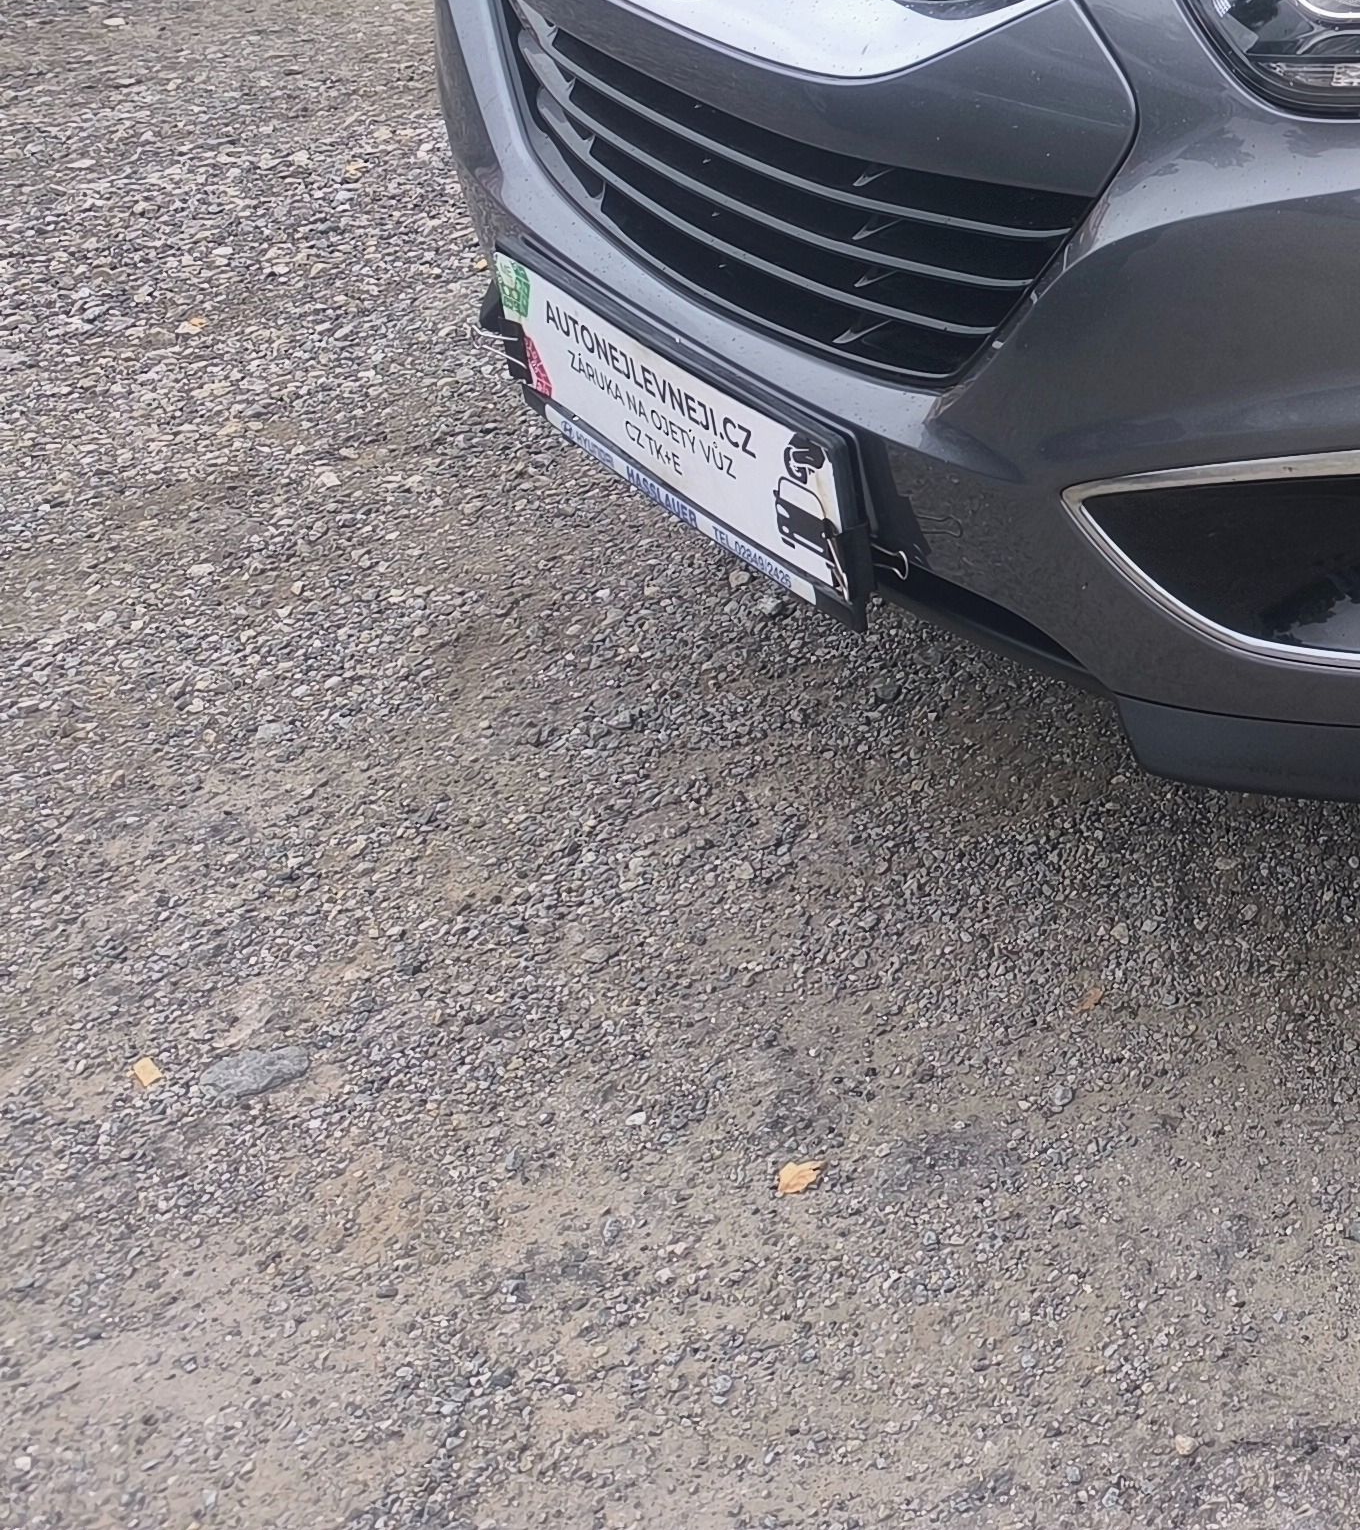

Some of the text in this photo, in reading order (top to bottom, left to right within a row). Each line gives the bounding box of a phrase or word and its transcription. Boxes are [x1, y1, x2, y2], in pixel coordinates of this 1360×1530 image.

[545, 299, 757, 459] AUTONEJLEVNEJI.CZ
[567, 349, 625, 406] ZÁRUKA
[625, 390, 649, 423] NA
[650, 409, 696, 454] OJETÝ
[699, 438, 737, 480] VŮZ
[625, 420, 683, 476] CZ TK+E
[626, 465, 698, 528] HASSLAUER
